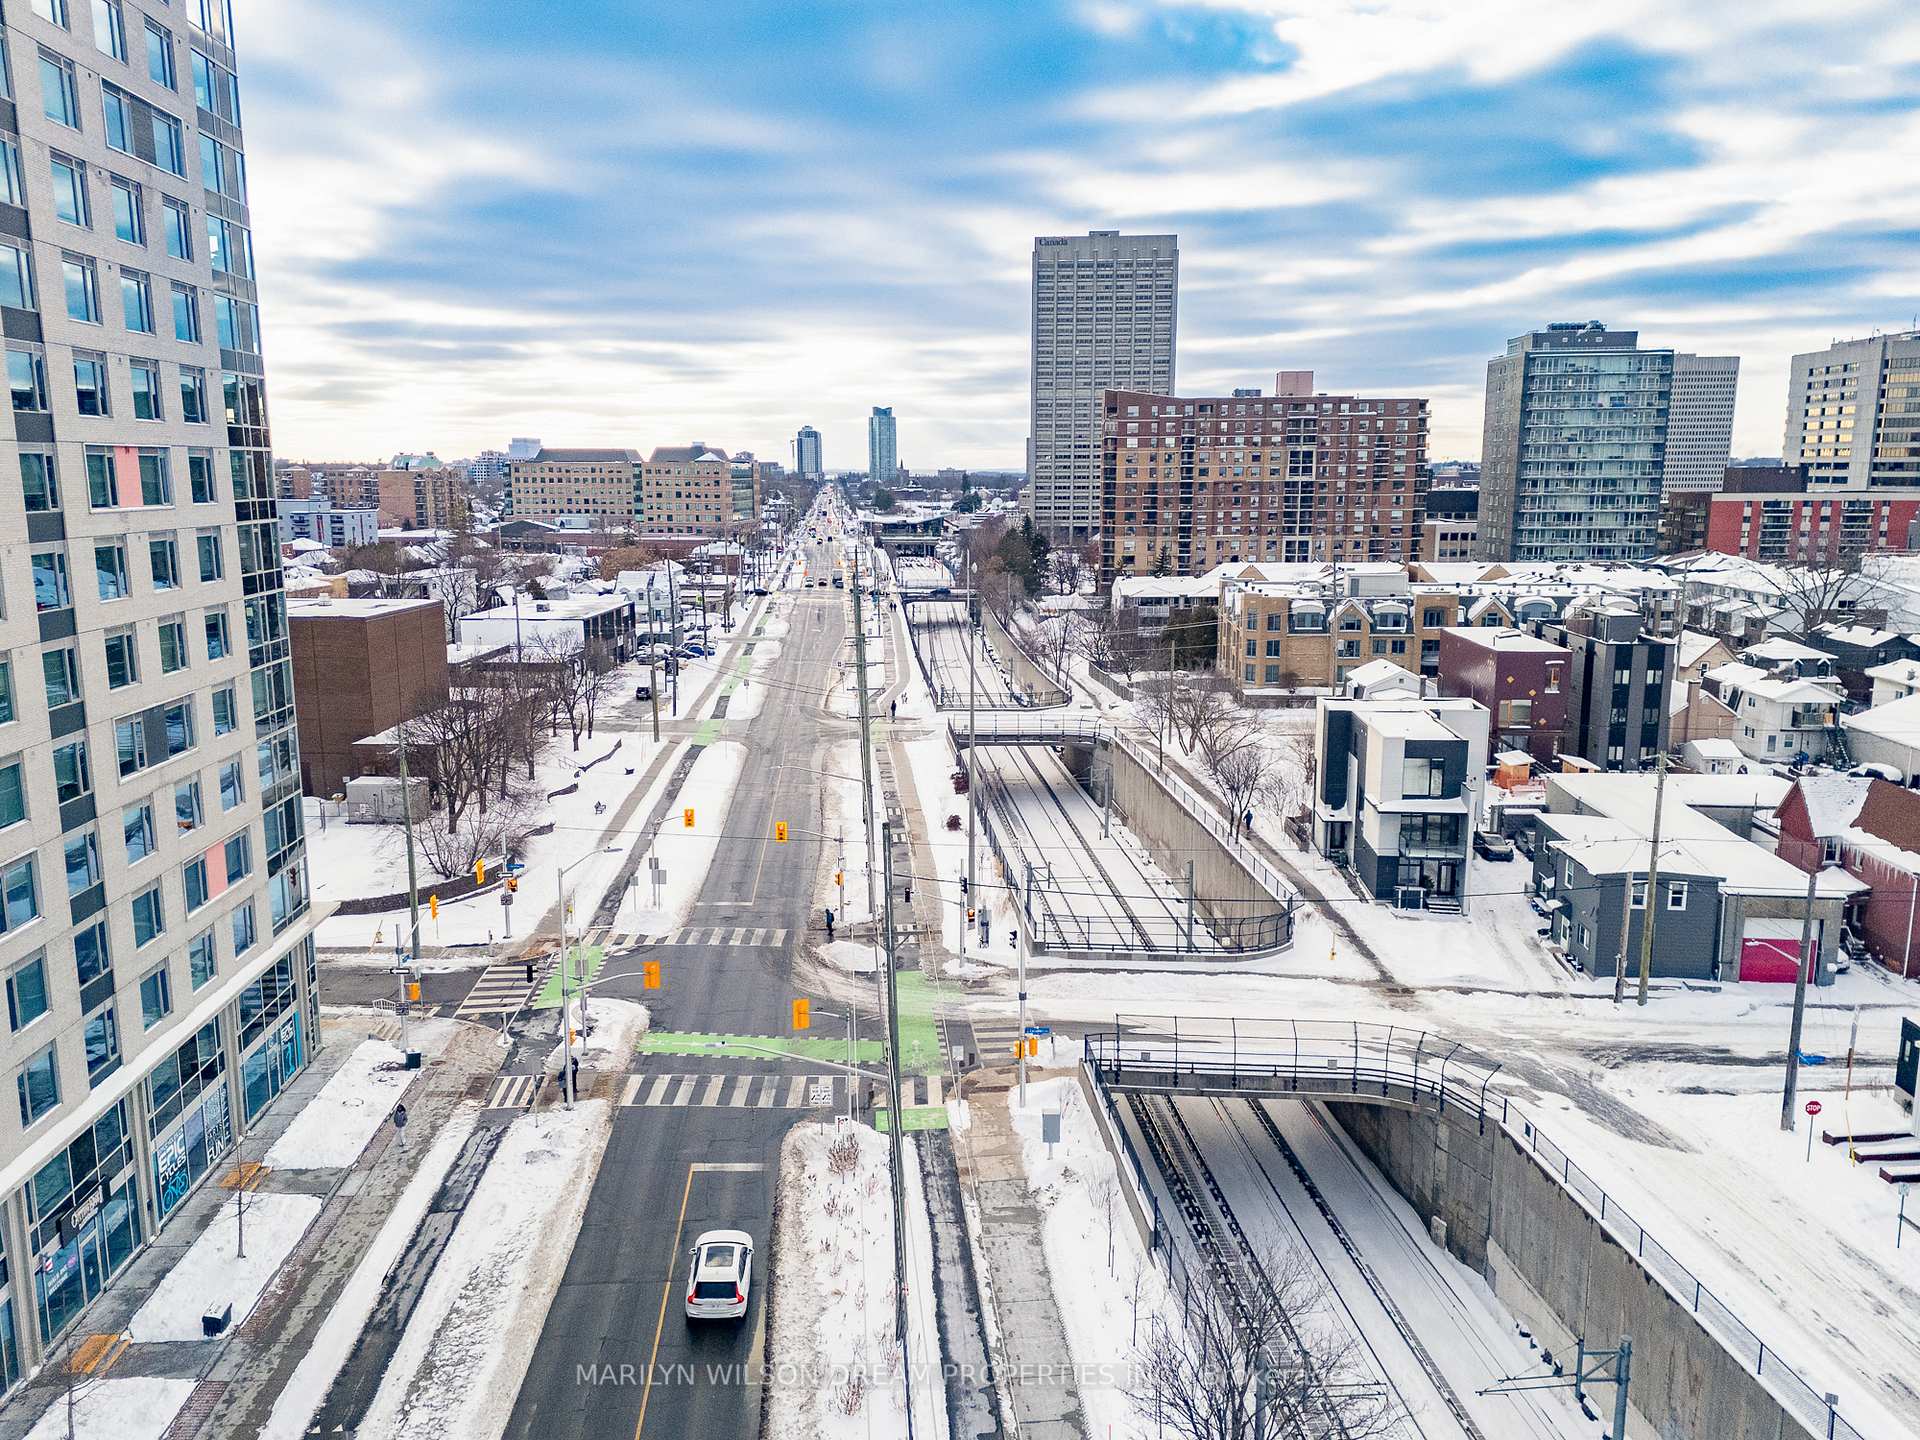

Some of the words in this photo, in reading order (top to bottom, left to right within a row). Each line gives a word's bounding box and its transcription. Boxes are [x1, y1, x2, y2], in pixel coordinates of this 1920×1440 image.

[1039, 237, 1068, 246] Canada
[160, 1135, 185, 1172] EPIC
[160, 1151, 187, 1185] CYCLES
